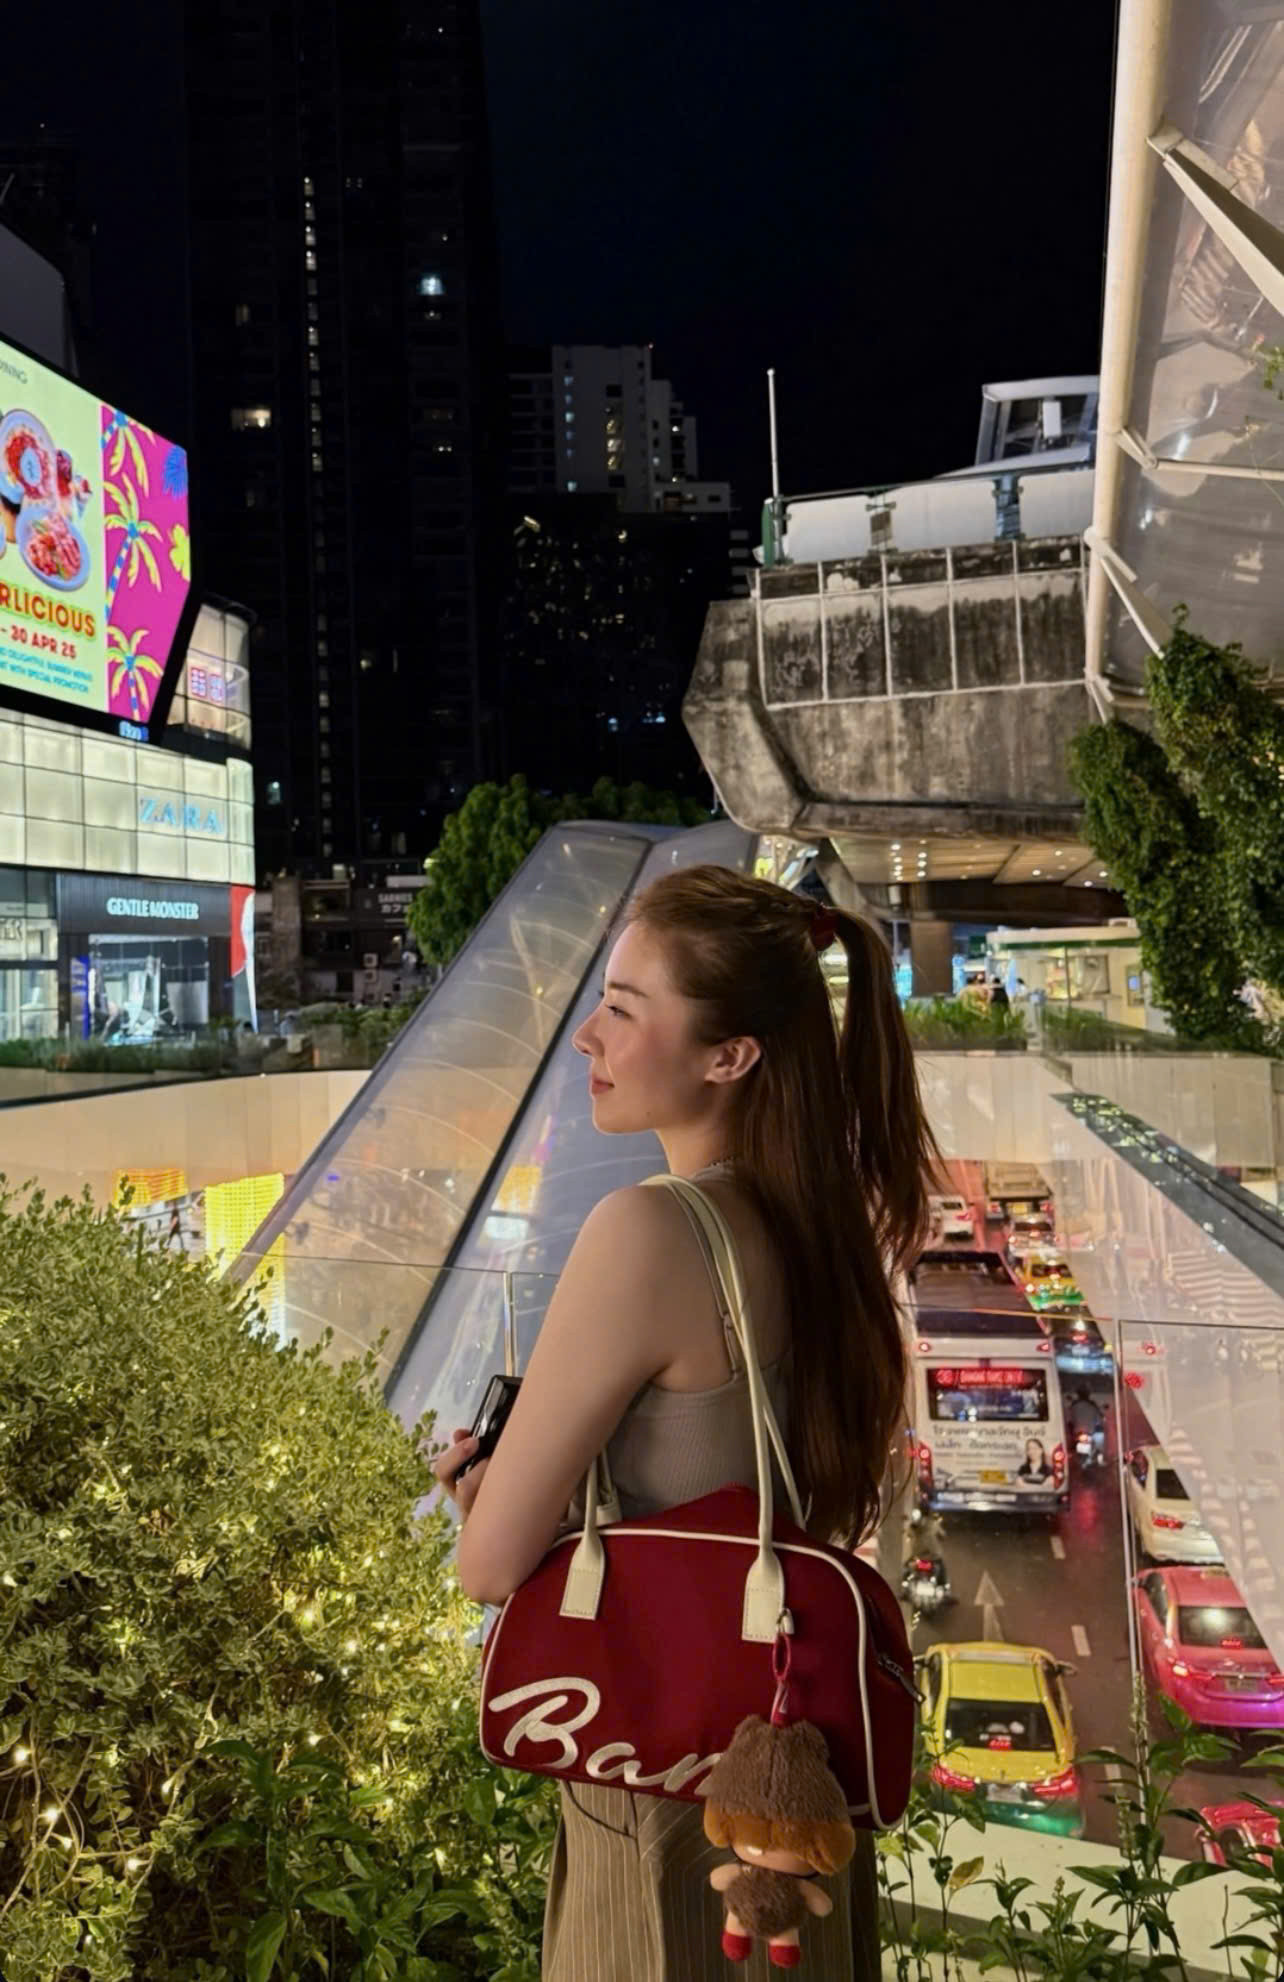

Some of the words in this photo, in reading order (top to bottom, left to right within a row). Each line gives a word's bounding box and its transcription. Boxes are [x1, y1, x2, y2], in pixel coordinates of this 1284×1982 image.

[32, 632, 57, 654] APR
[61, 641, 76, 660] 25
[139, 797, 223, 834] ZARA
[106, 896, 149, 917] GENTLE
[150, 901, 199, 920] MONSTER
